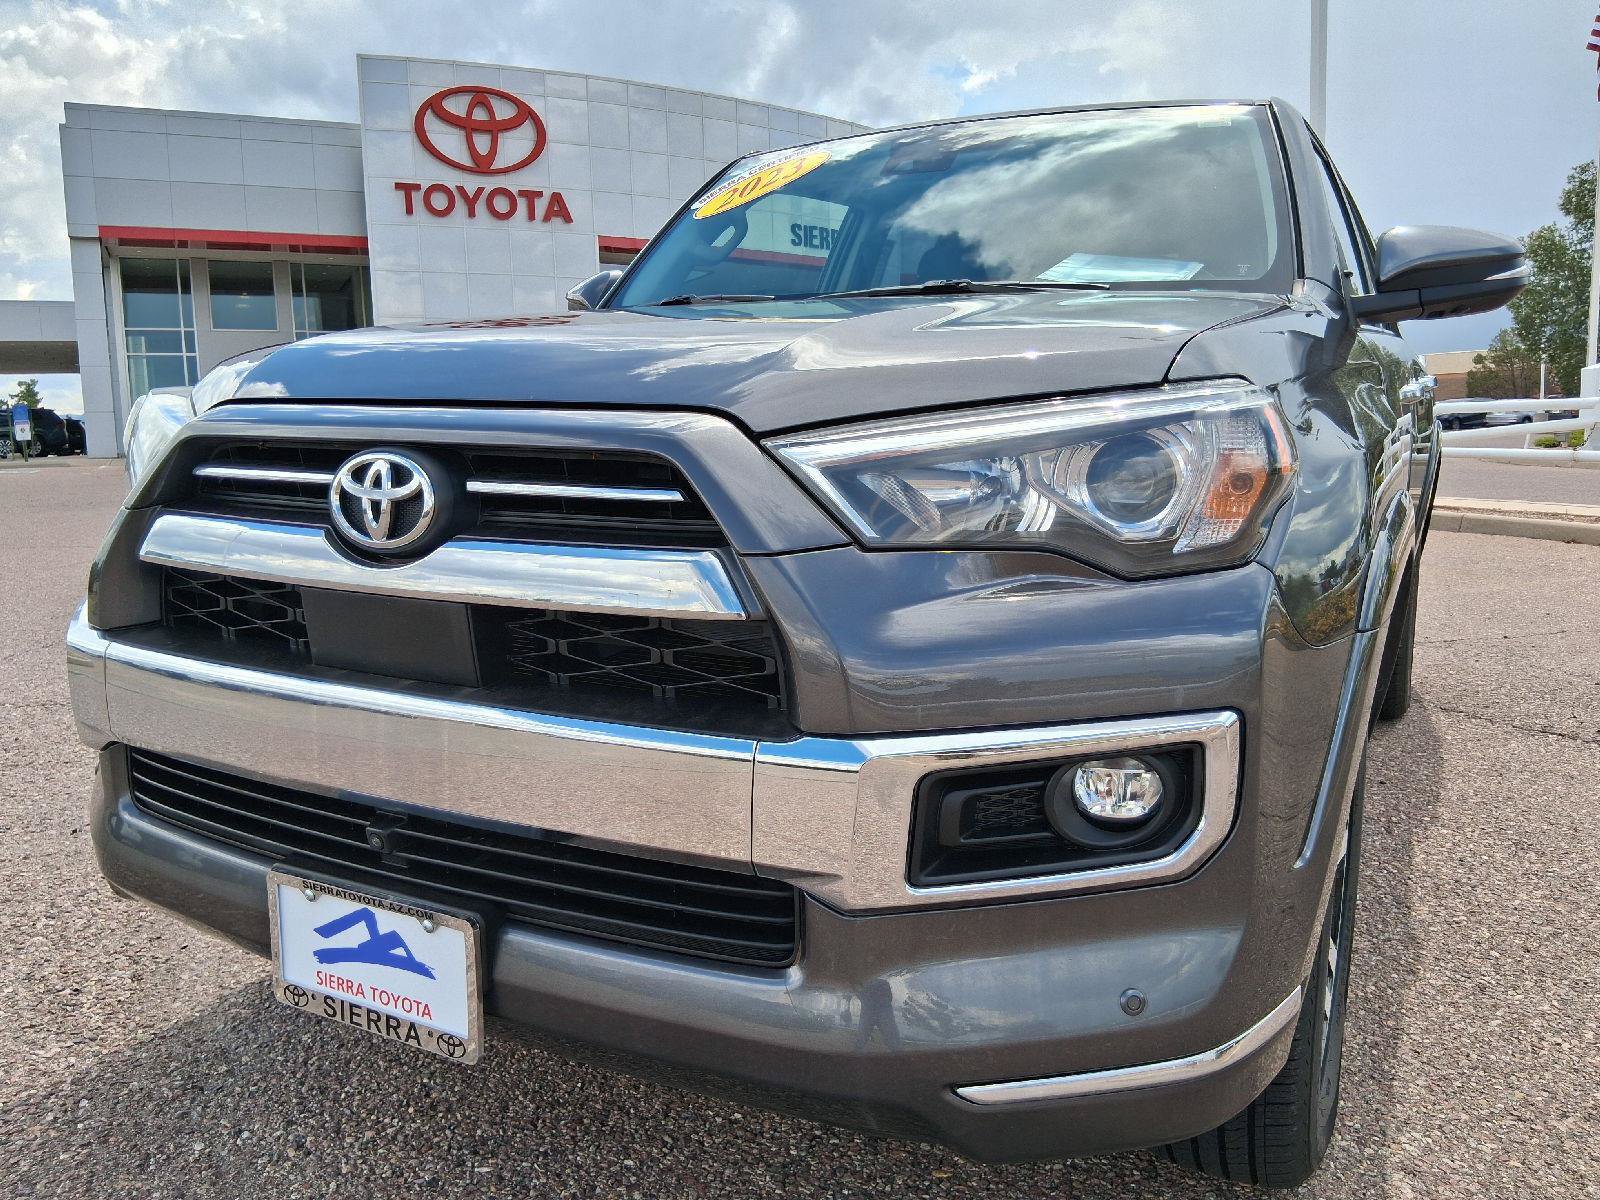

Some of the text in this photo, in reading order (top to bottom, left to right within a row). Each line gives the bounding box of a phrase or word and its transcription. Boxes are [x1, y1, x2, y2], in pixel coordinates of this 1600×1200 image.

[394, 182, 574, 224] TOYOTA
[715, 157, 806, 211] 2023
[302, 880, 434, 920] SIERRATOYOTA-AZ.COM
[316, 970, 432, 1020] SIERRA TOYOTA
[323, 994, 421, 1046] SIERRA
